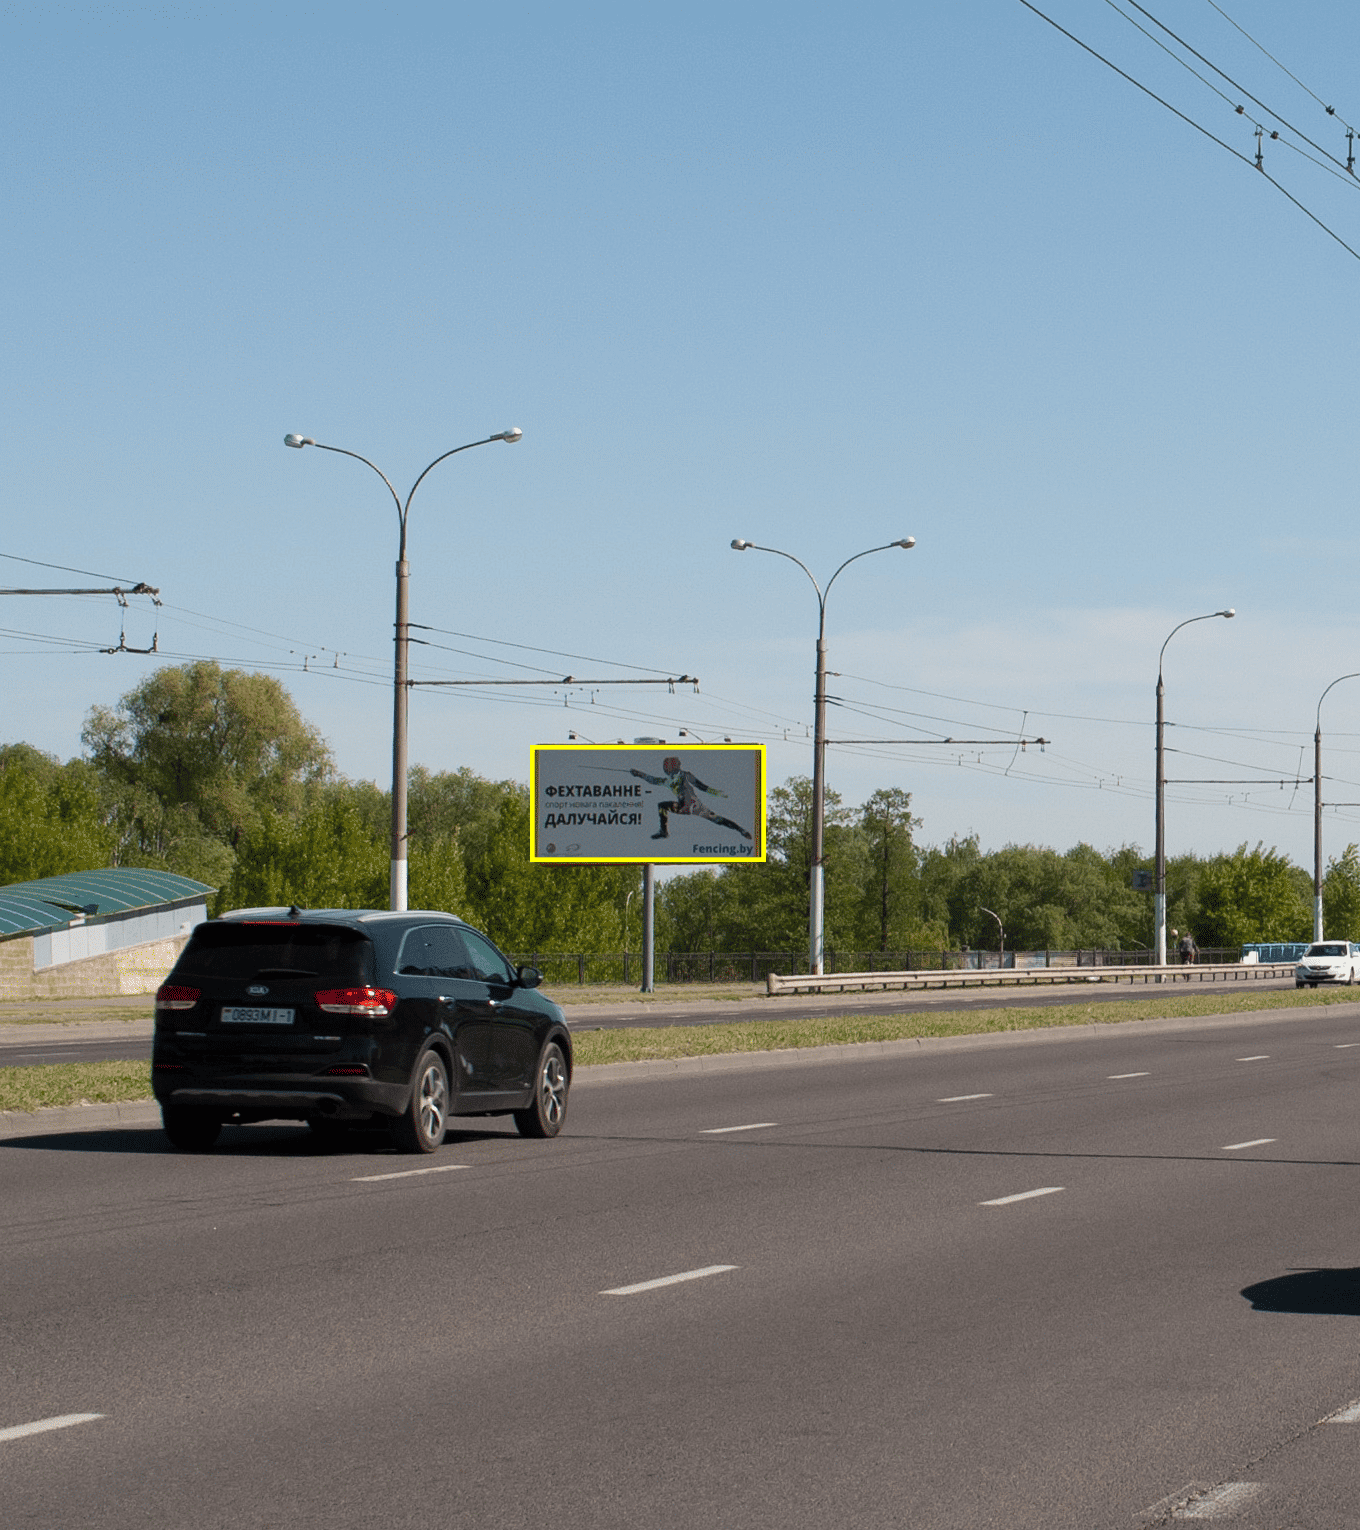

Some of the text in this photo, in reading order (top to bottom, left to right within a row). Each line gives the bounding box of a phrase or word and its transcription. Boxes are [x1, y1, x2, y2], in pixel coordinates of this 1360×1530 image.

[545, 785, 642, 797] ФЕХТАВАННЕ
[544, 809, 642, 828] ДАЛУЧАЙСЯ!
[692, 843, 754, 856] Fencing.by
